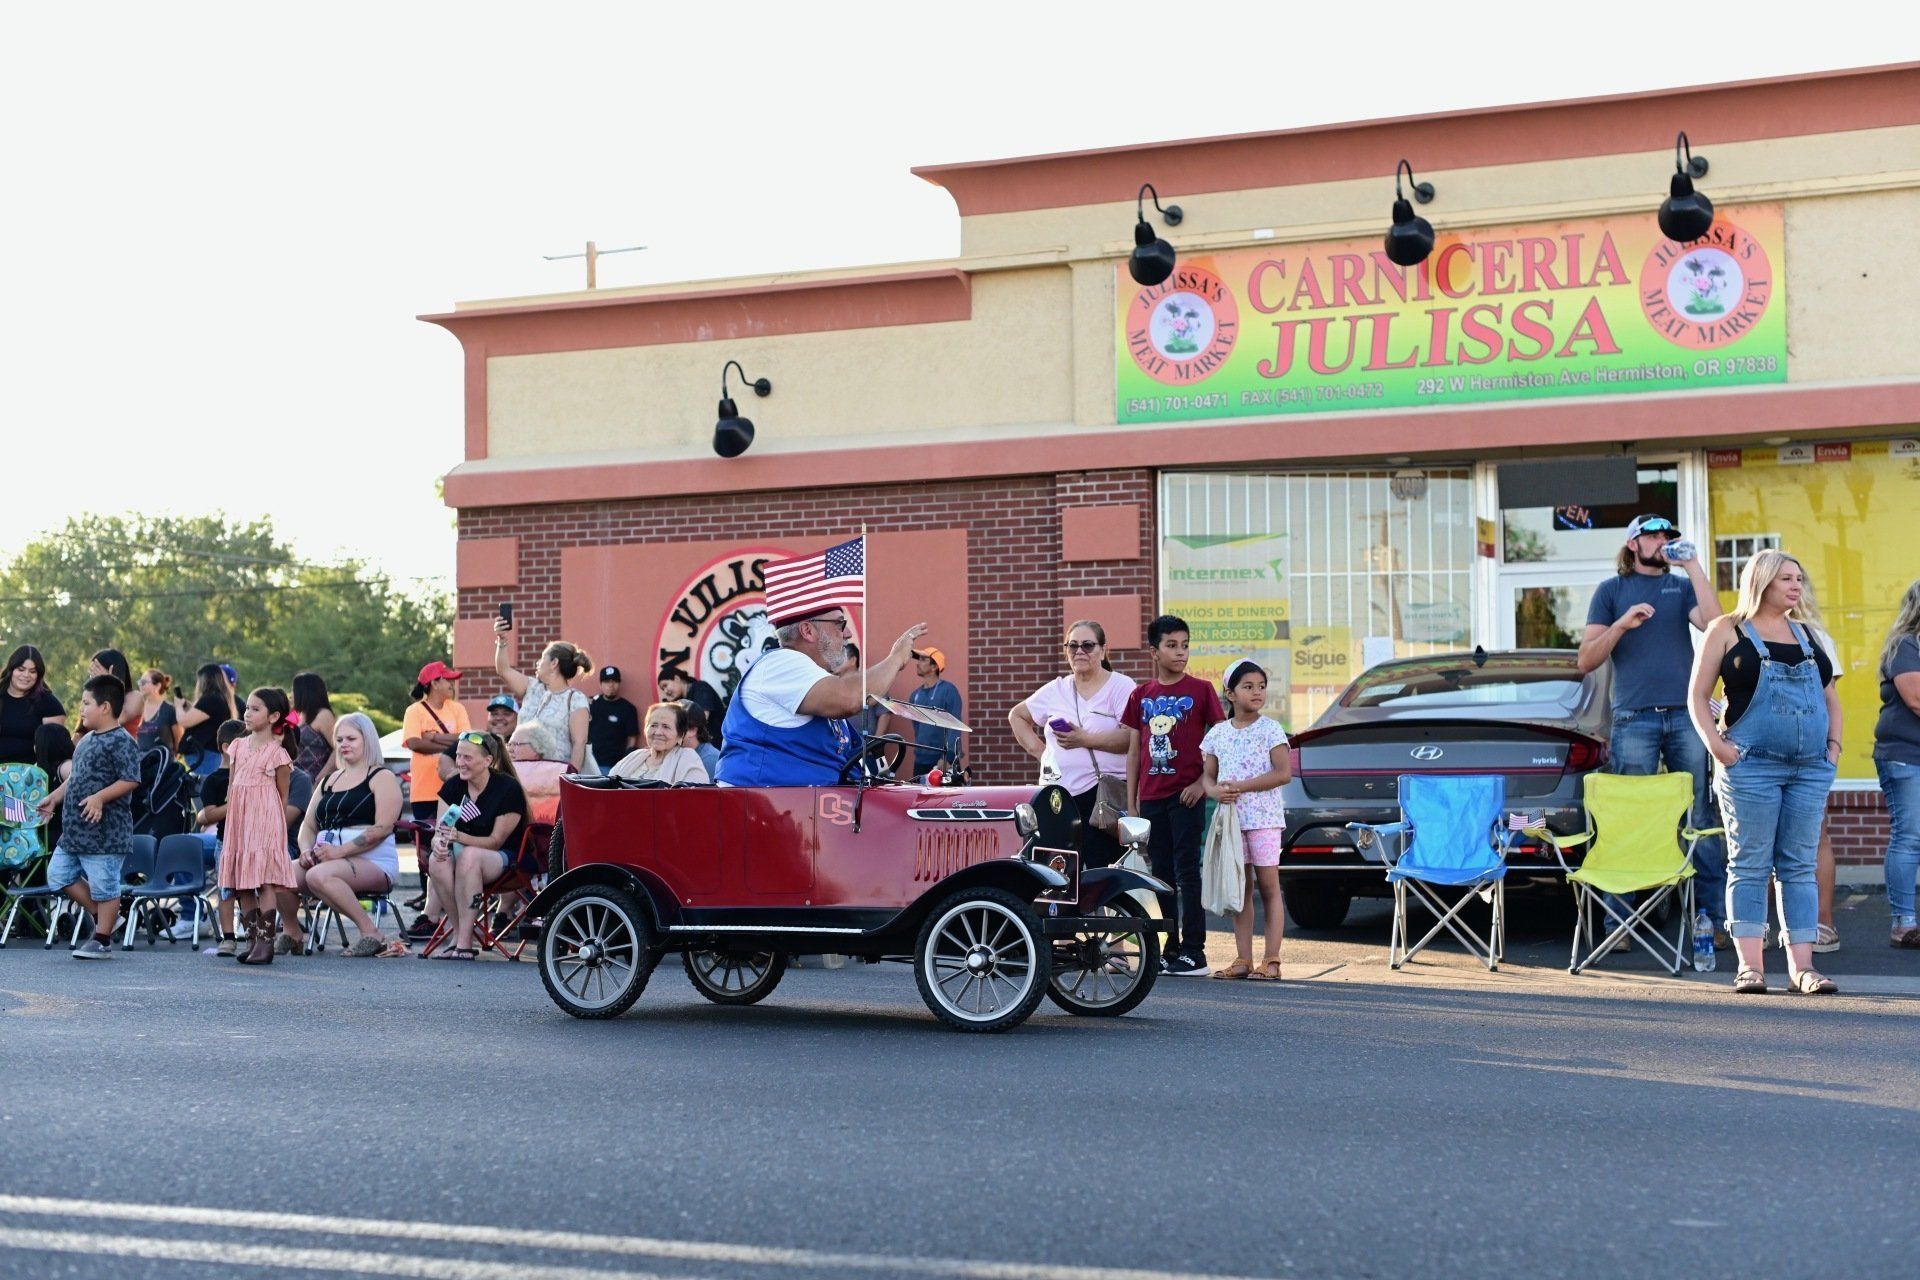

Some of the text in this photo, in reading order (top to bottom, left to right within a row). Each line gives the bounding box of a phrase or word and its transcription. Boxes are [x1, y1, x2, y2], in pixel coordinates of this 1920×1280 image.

[1655, 224, 1757, 268] JUSSA'S
[1247, 229, 1631, 315] CARNICERIA
[1644, 277, 1768, 345] MEAT MARKET
[1129, 319, 1236, 381] MEAT MARKET
[1256, 295, 1623, 378] JULISSA
[1416, 356, 1777, 395] 292 W Hermiston Ave Hermiston, OR 97838
[1126, 383, 1383, 417] (541) 701-0471 FAX (541) 701-0472
[1168, 565, 1265, 580] intermex
[1168, 606, 1285, 617] ENVÍOS DE DINERO
[1212, 628, 1265, 640] RODEOS
[1295, 650, 1347, 669] Sigue
[1532, 757, 1558, 765] hybrid
